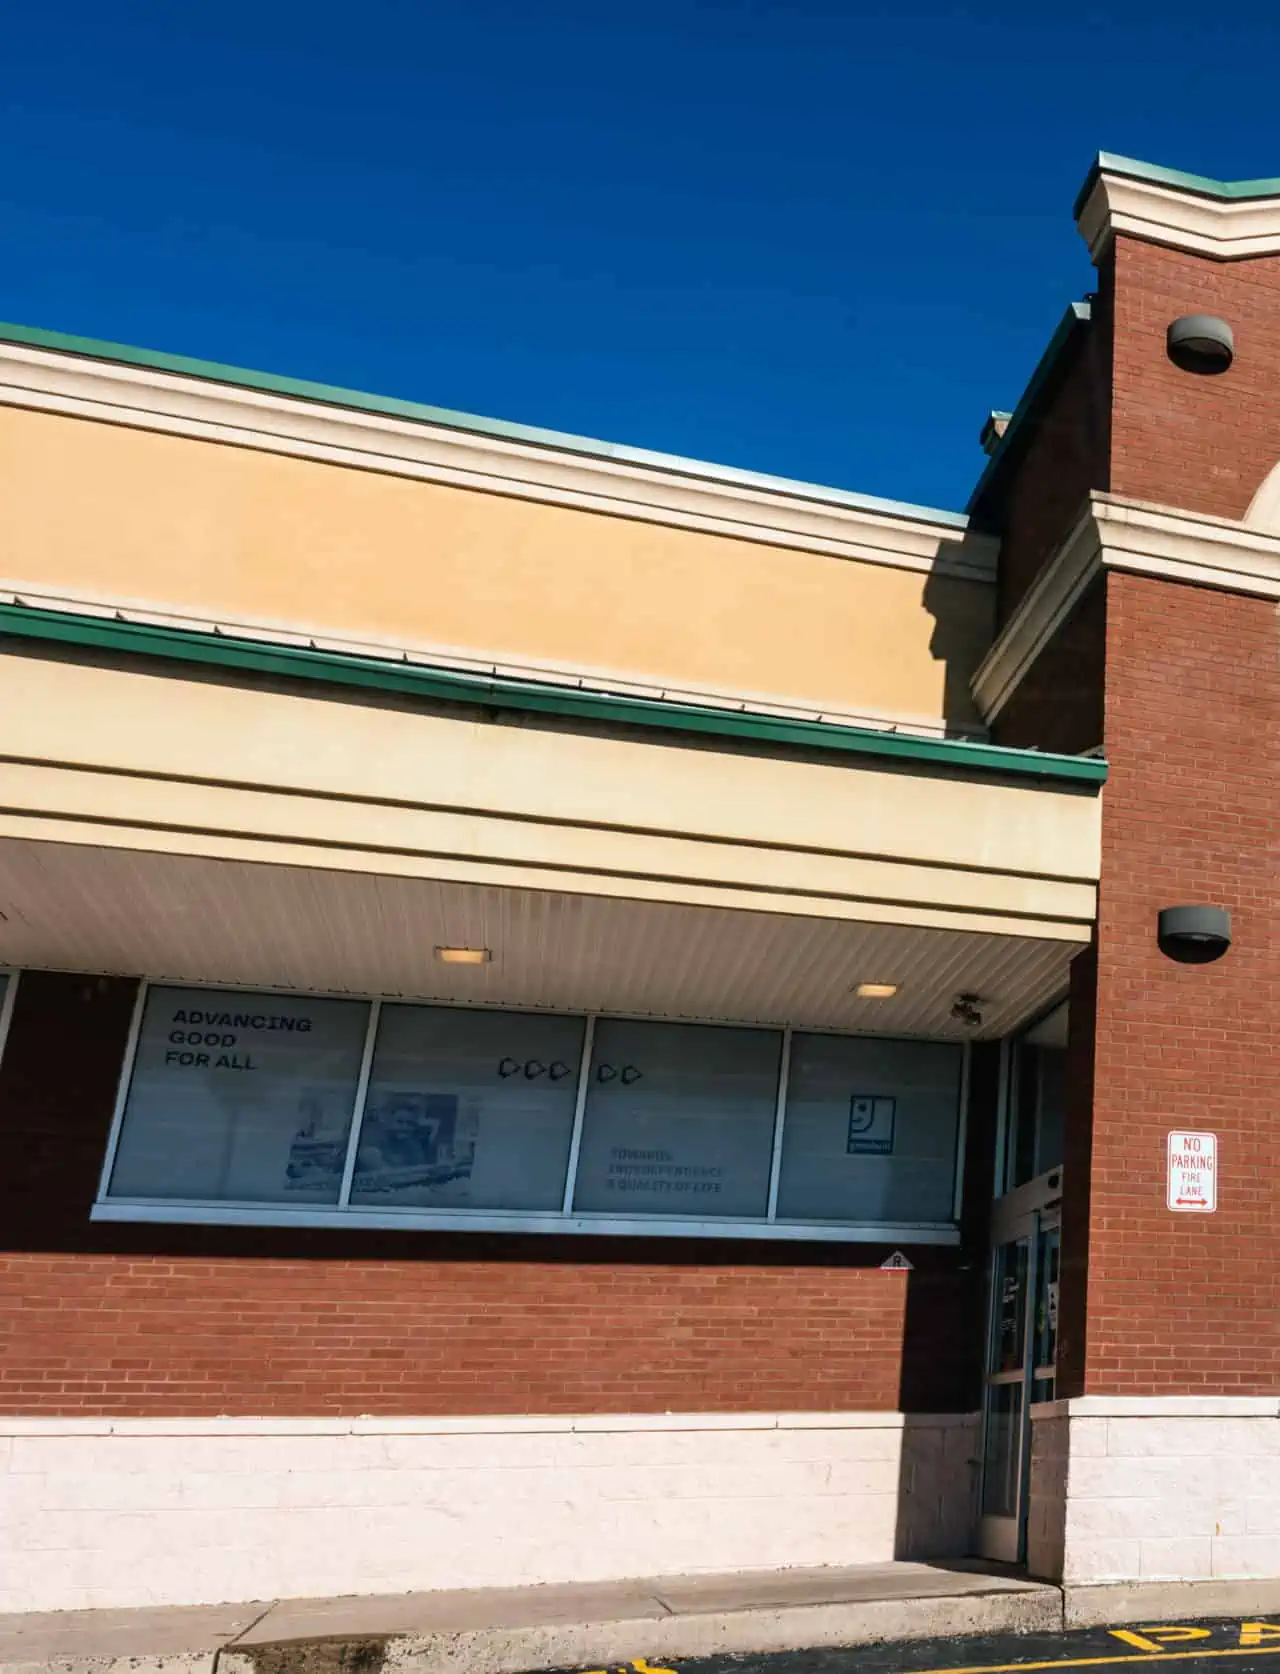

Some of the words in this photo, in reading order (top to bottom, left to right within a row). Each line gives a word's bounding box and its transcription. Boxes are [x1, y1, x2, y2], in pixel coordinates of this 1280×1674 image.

[172, 1009, 313, 1032] ADVANCING
[168, 1030, 236, 1048] GOOD
[165, 1048, 210, 1067] FOR
[215, 1052, 257, 1071] ALL
[1183, 1137, 1201, 1152] NO
[1171, 1154, 1213, 1170] PARKING
[1181, 1172, 1201, 1184] FIRE
[1180, 1185, 1204, 1197] LANE
